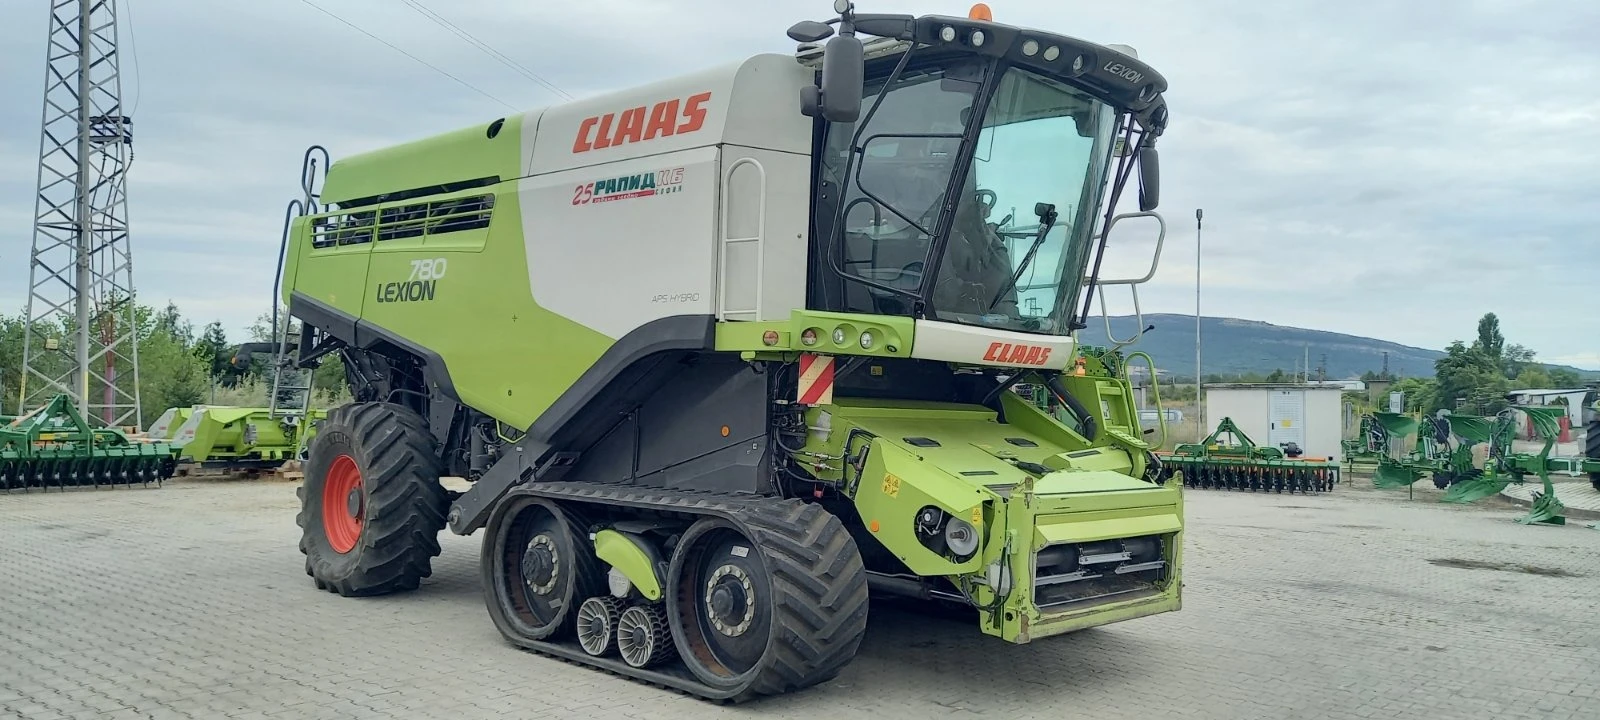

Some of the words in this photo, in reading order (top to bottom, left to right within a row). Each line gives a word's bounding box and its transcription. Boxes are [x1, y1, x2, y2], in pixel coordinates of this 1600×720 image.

[1104, 61, 1144, 83] LEXION
[572, 92, 711, 153] CLAAS
[572, 183, 594, 205] 25
[594, 172, 656, 195] РАПИД
[408, 258, 447, 281] 780
[377, 280, 436, 303] LEXION
[983, 342, 1051, 365] CLAAS
